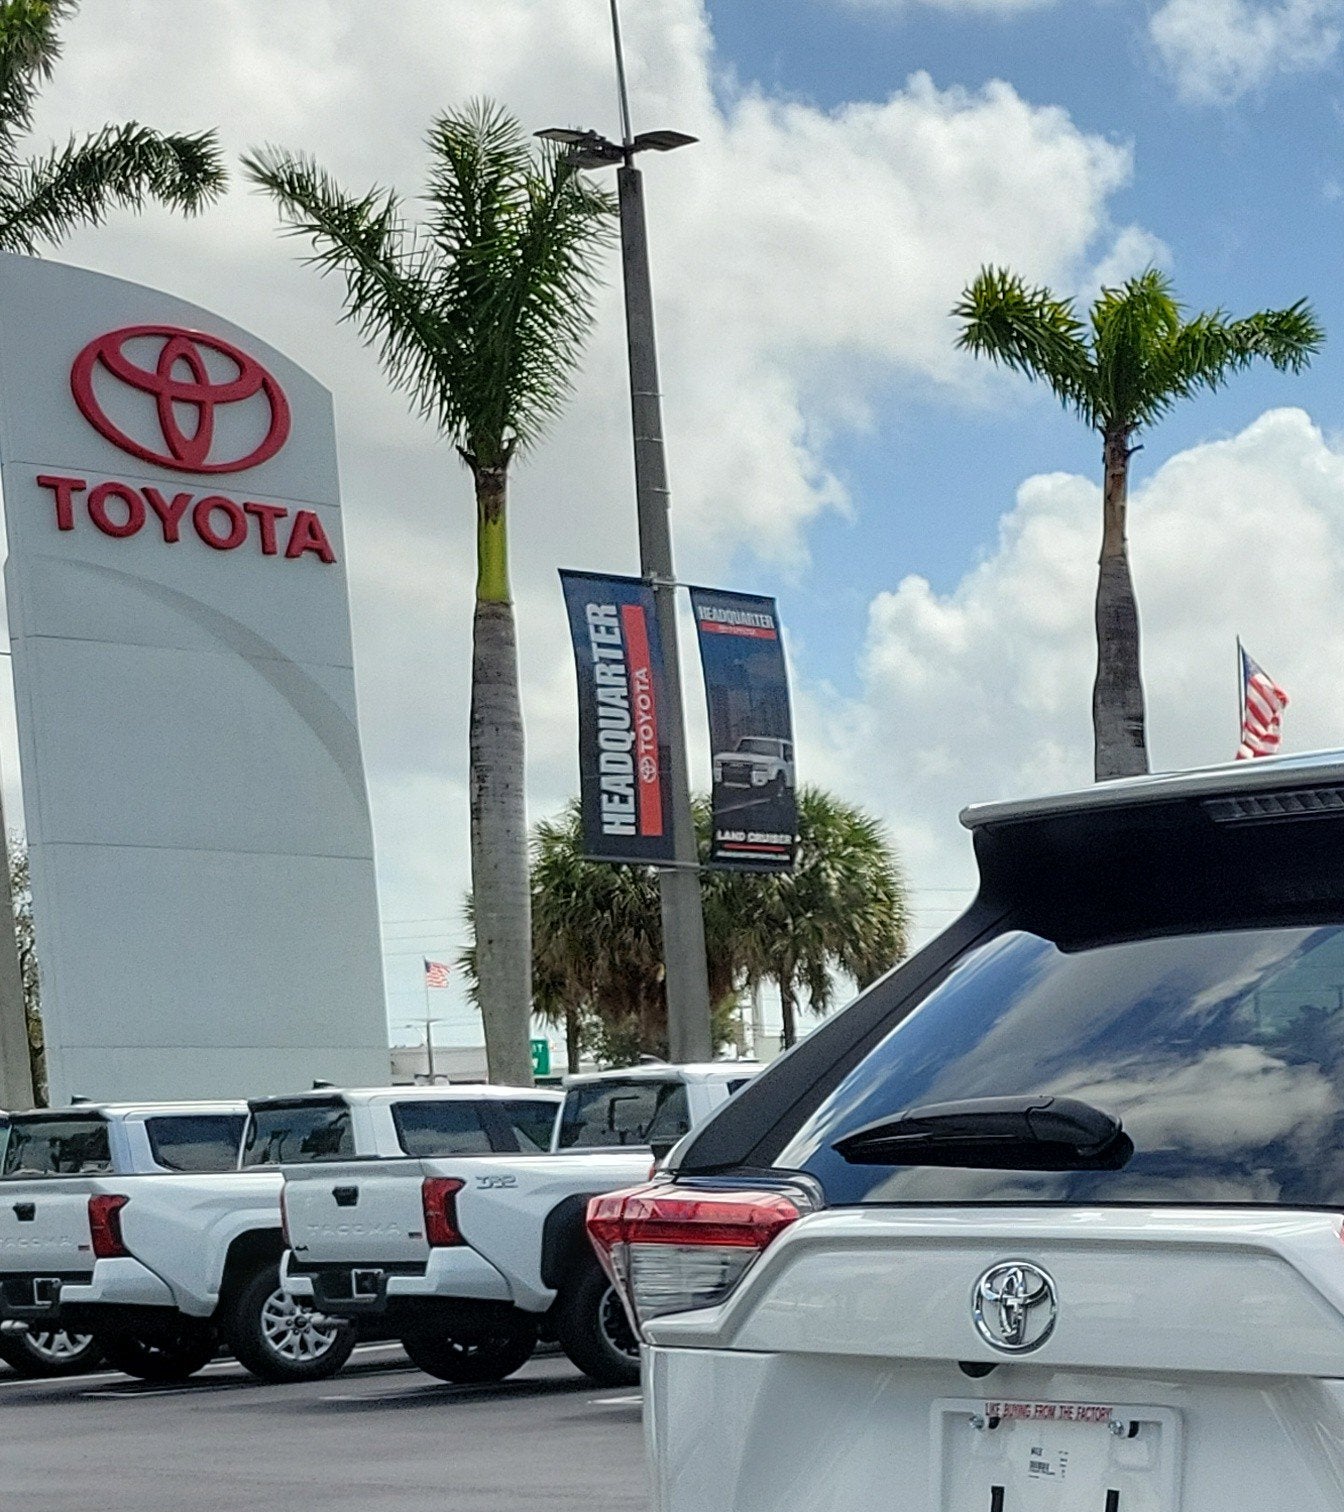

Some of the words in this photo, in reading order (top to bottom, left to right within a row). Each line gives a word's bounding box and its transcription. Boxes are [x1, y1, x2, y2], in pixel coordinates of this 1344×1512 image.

[36, 475, 337, 564] TOYOTA
[585, 602, 636, 836] HEADQUARTER
[635, 667, 656, 754] TOYOTA
